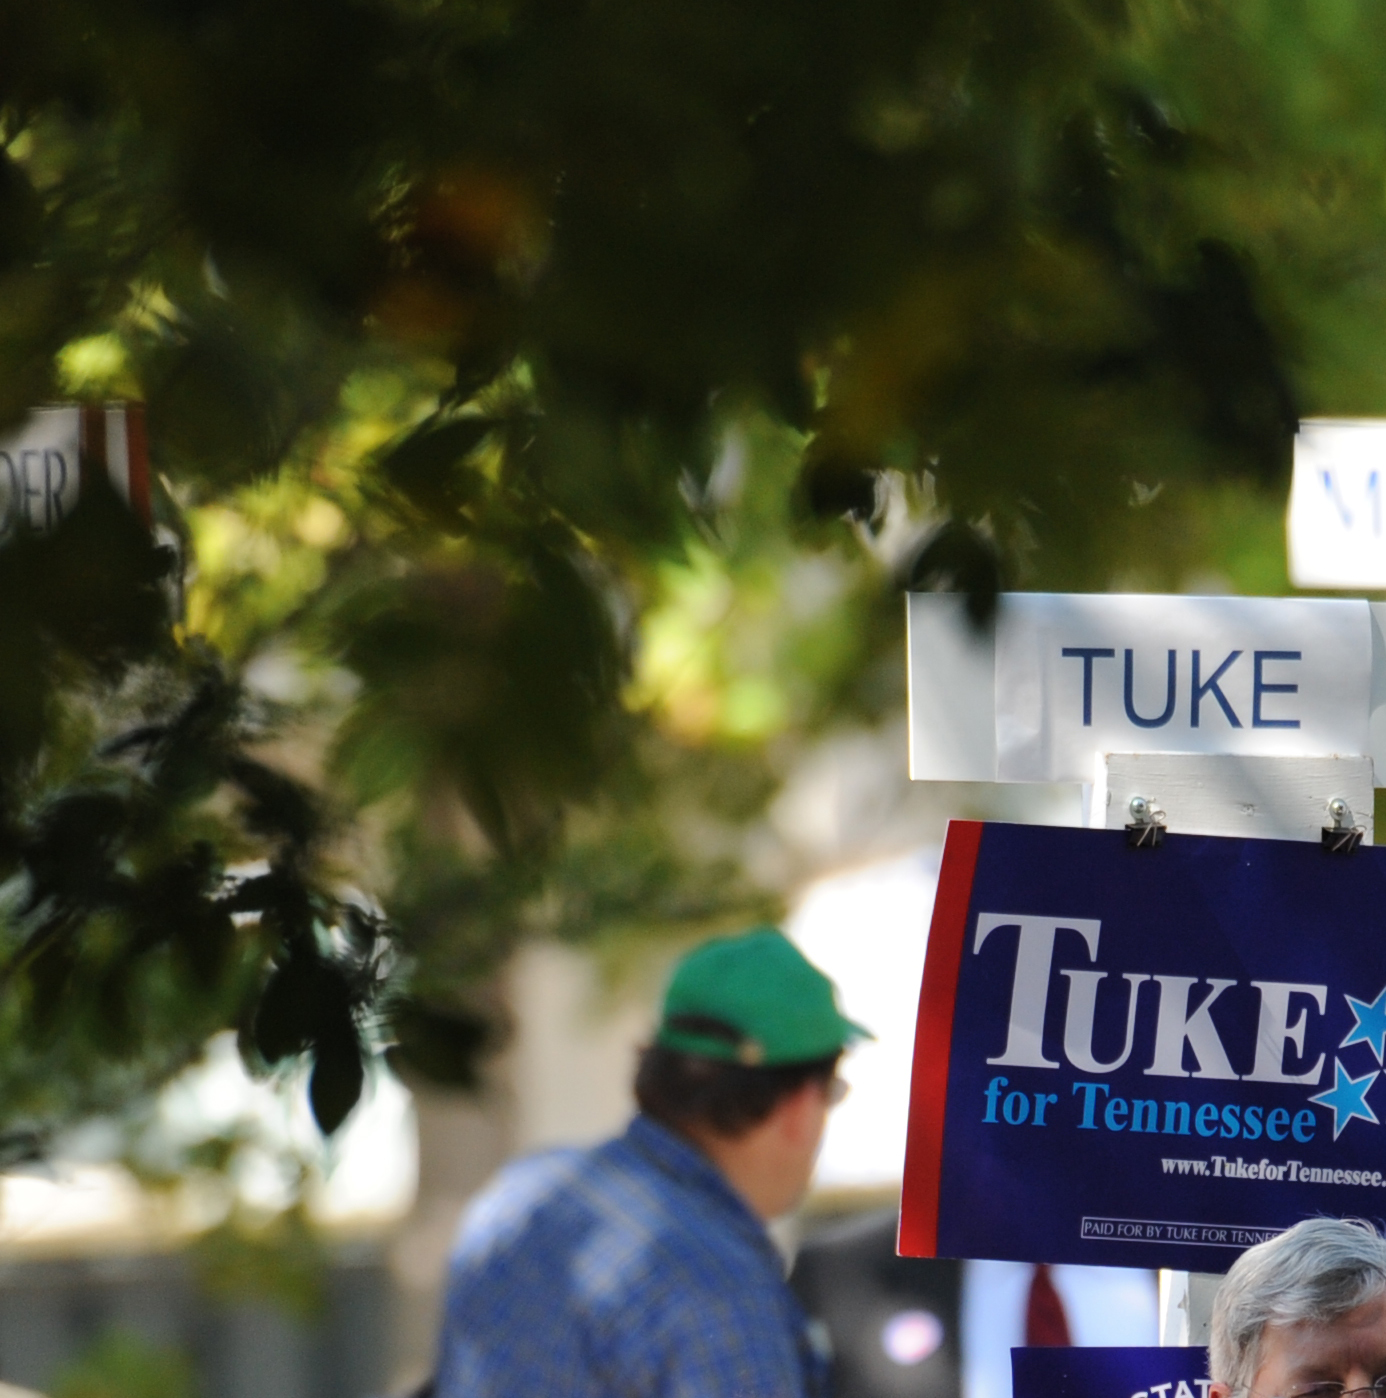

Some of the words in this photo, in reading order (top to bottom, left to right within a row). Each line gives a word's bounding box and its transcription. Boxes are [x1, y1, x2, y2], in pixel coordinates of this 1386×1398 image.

[1061, 647, 1303, 728] TUKE
[981, 1076, 1058, 1126] for
[1072, 1081, 1317, 1143] Tennessee
[1084, 1221, 1114, 1236] PAID
[1117, 1223, 1143, 1238] FOR
[1146, 1226, 1163, 1239] BY
[1166, 1226, 1198, 1241] TUKE
[1202, 1228, 1227, 1243] FOR
